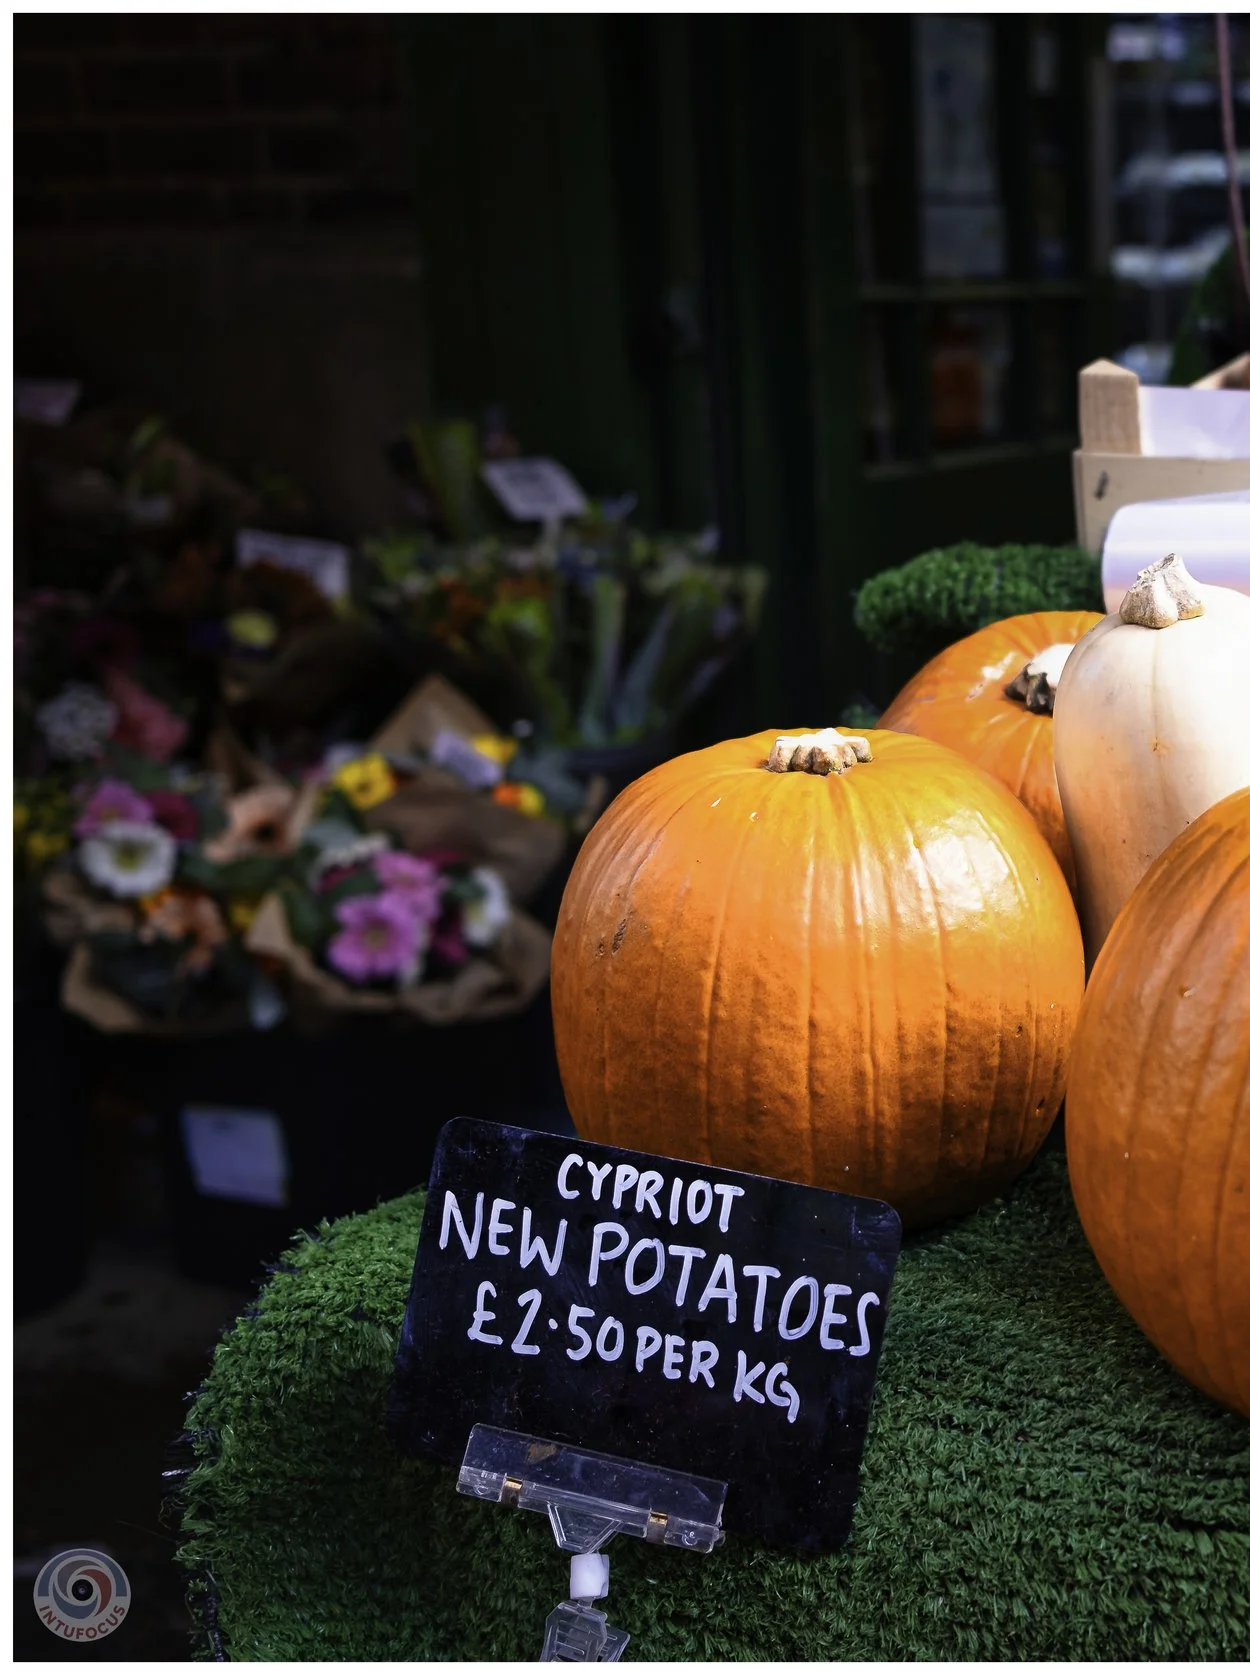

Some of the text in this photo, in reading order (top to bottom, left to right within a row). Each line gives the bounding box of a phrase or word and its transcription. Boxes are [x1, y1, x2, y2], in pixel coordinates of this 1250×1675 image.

[557, 1153, 746, 1233] CYPRIOT
[438, 1190, 881, 1357] NEW POTATOES
[635, 1325, 720, 1389] PER
[733, 1349, 800, 1424] KG
